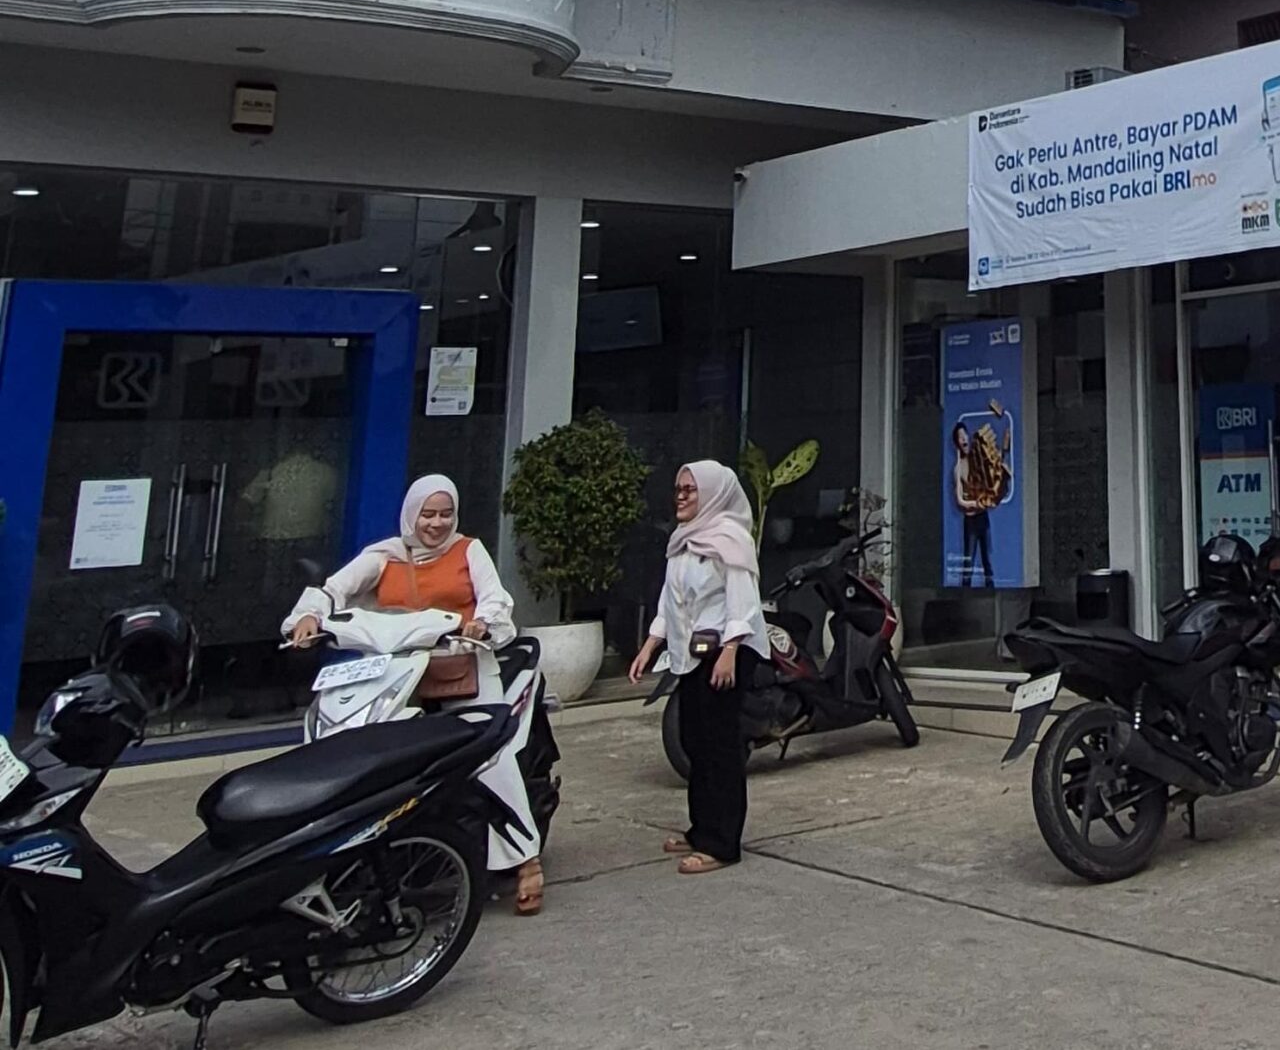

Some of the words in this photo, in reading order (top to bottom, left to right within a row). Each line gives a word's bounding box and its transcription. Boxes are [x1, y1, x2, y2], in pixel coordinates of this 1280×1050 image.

[995, 152, 1024, 172] Gak
[1028, 141, 1067, 165] Perlu
[1072, 133, 1122, 157] Antre,
[1127, 120, 1178, 147] Bayar
[1183, 104, 1238, 134] PDAM
[1010, 173, 1025, 194] di
[1028, 169, 1064, 191] Kab.
[1067, 149, 1164, 184] Mandailing
[1169, 135, 1218, 164] Natal
[1016, 193, 1067, 218] Sudah
[1070, 187, 1105, 209] Bisa
[1110, 173, 1158, 199] Pakai
[1163, 169, 1217, 193] BRImo
[1233, 407, 1257, 427] BRI
[1217, 473, 1262, 493] ATM
